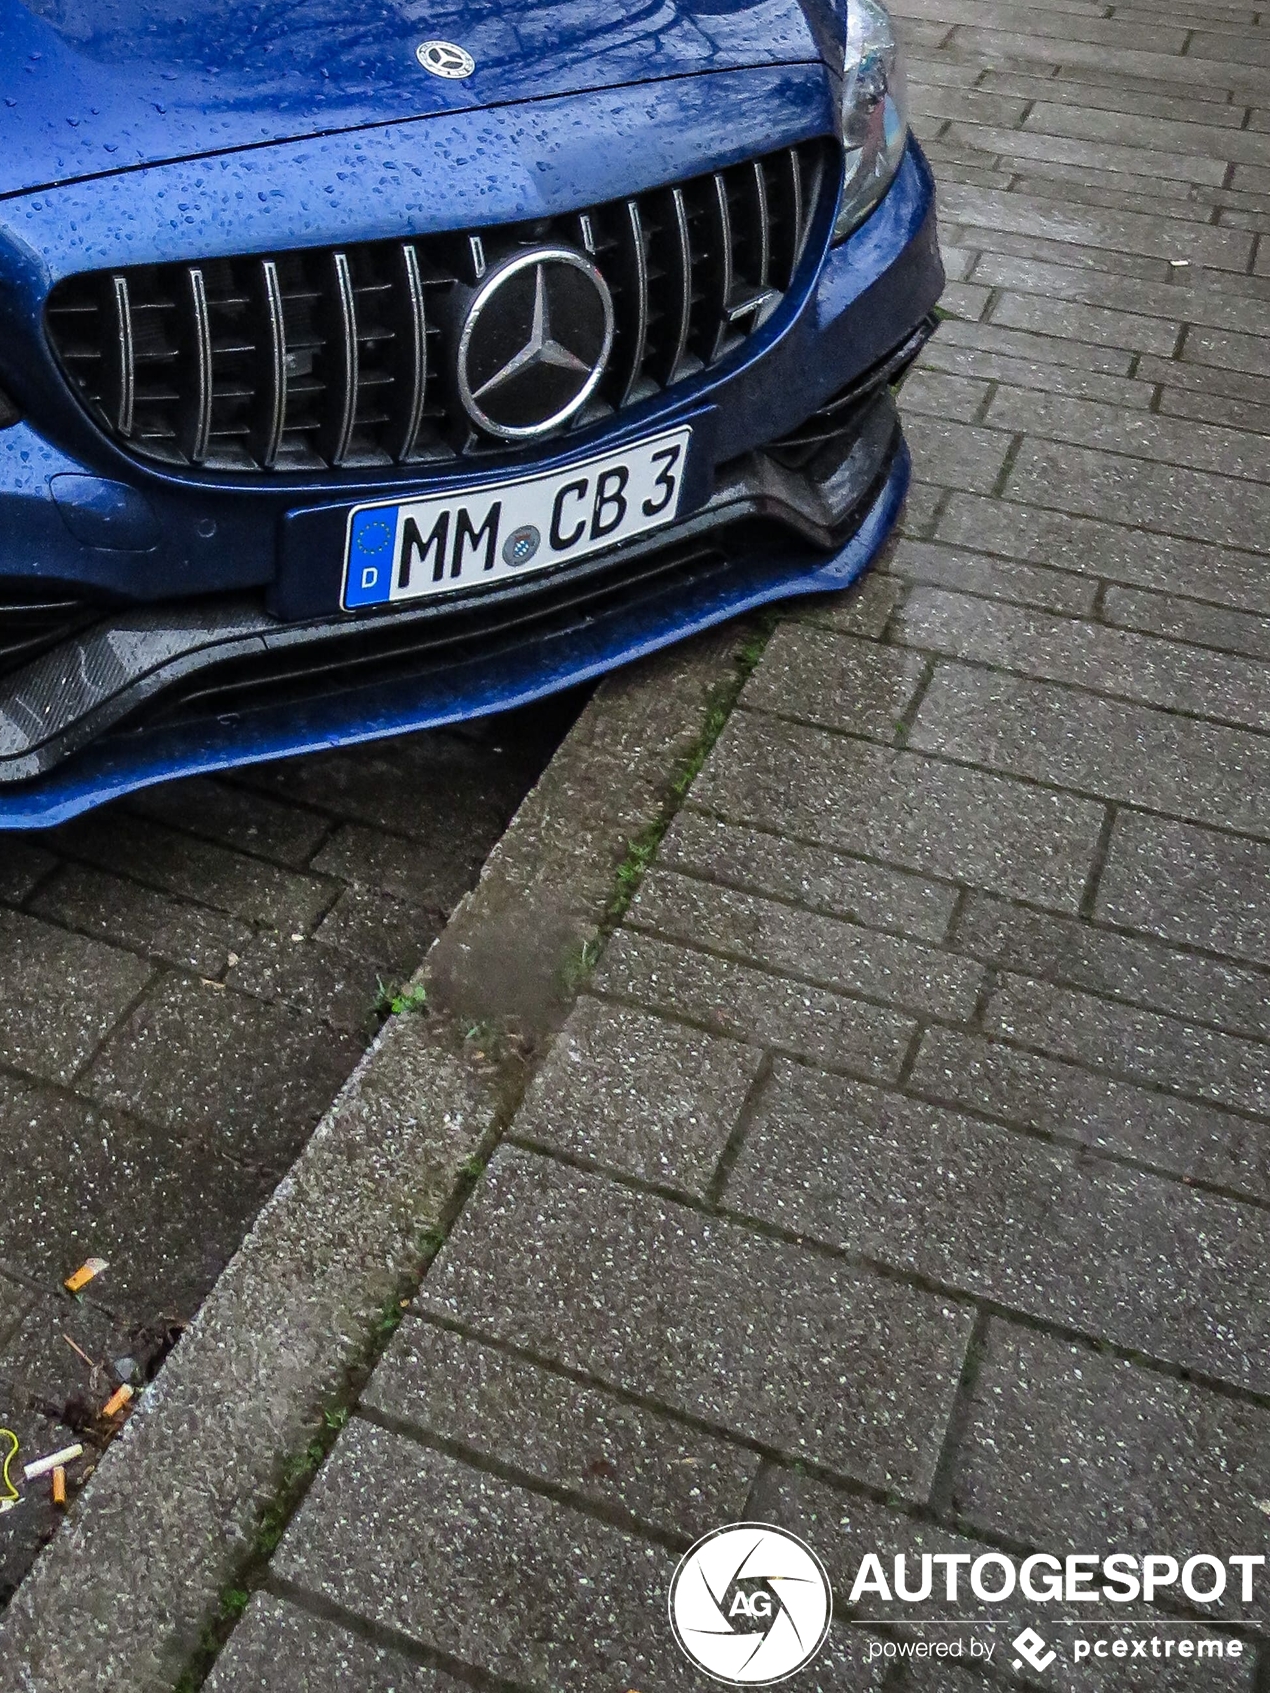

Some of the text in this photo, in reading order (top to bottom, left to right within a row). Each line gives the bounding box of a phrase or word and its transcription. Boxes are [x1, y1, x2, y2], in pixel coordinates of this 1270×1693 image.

[397, 444, 681, 588] MM CB 3
[361, 567, 378, 589] D
